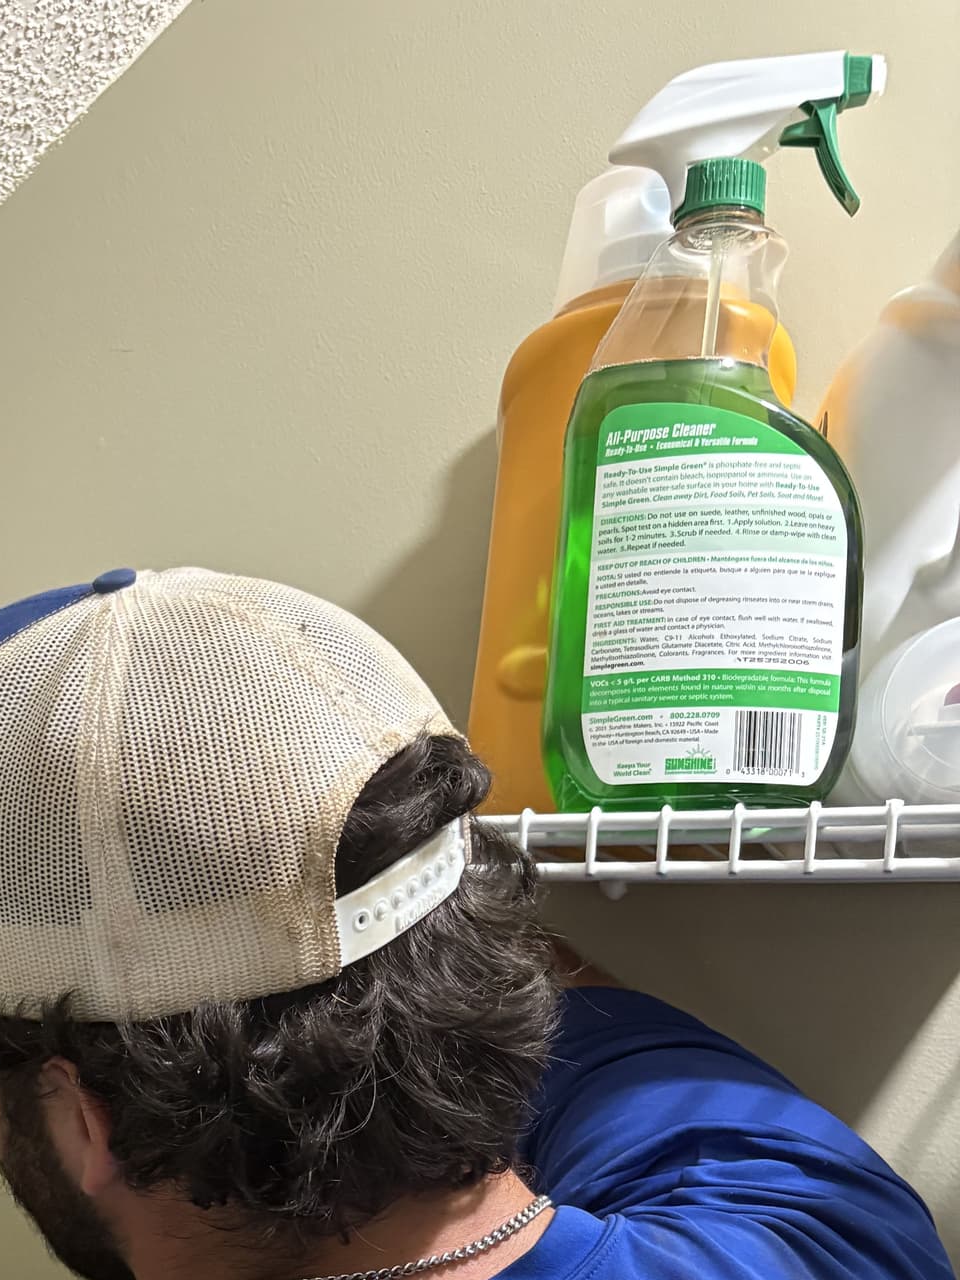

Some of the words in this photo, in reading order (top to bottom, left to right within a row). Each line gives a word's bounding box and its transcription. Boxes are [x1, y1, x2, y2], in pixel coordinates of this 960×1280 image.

[606, 427, 669, 446] All-Purpose
[672, 423, 716, 437] Cleaner
[605, 445, 647, 457] Ready-To-Use
[657, 438, 692, 450] Economical
[604, 466, 652, 479] Ready-To-Use
[654, 464, 679, 473] Simple
[601, 514, 646, 525] DIRECTIONS:
[700, 508, 722, 516] suede,
[752, 509, 786, 517] unfinished
[622, 525, 637, 533] Spot
[668, 519, 692, 527] hidden
[755, 519, 782, 527] solution.
[818, 523, 835, 532] heavy
[637, 532, 666, 540] minutes.
[705, 528, 733, 536] needed.
[821, 532, 836, 541] clean
[658, 540, 685, 548] needed.
[598, 563, 613, 571] KEEP
[640, 559, 661, 567] REACH
[590, 714, 653, 724] SimpleGreen.com
[665, 758, 713, 770] SUNSHINE
